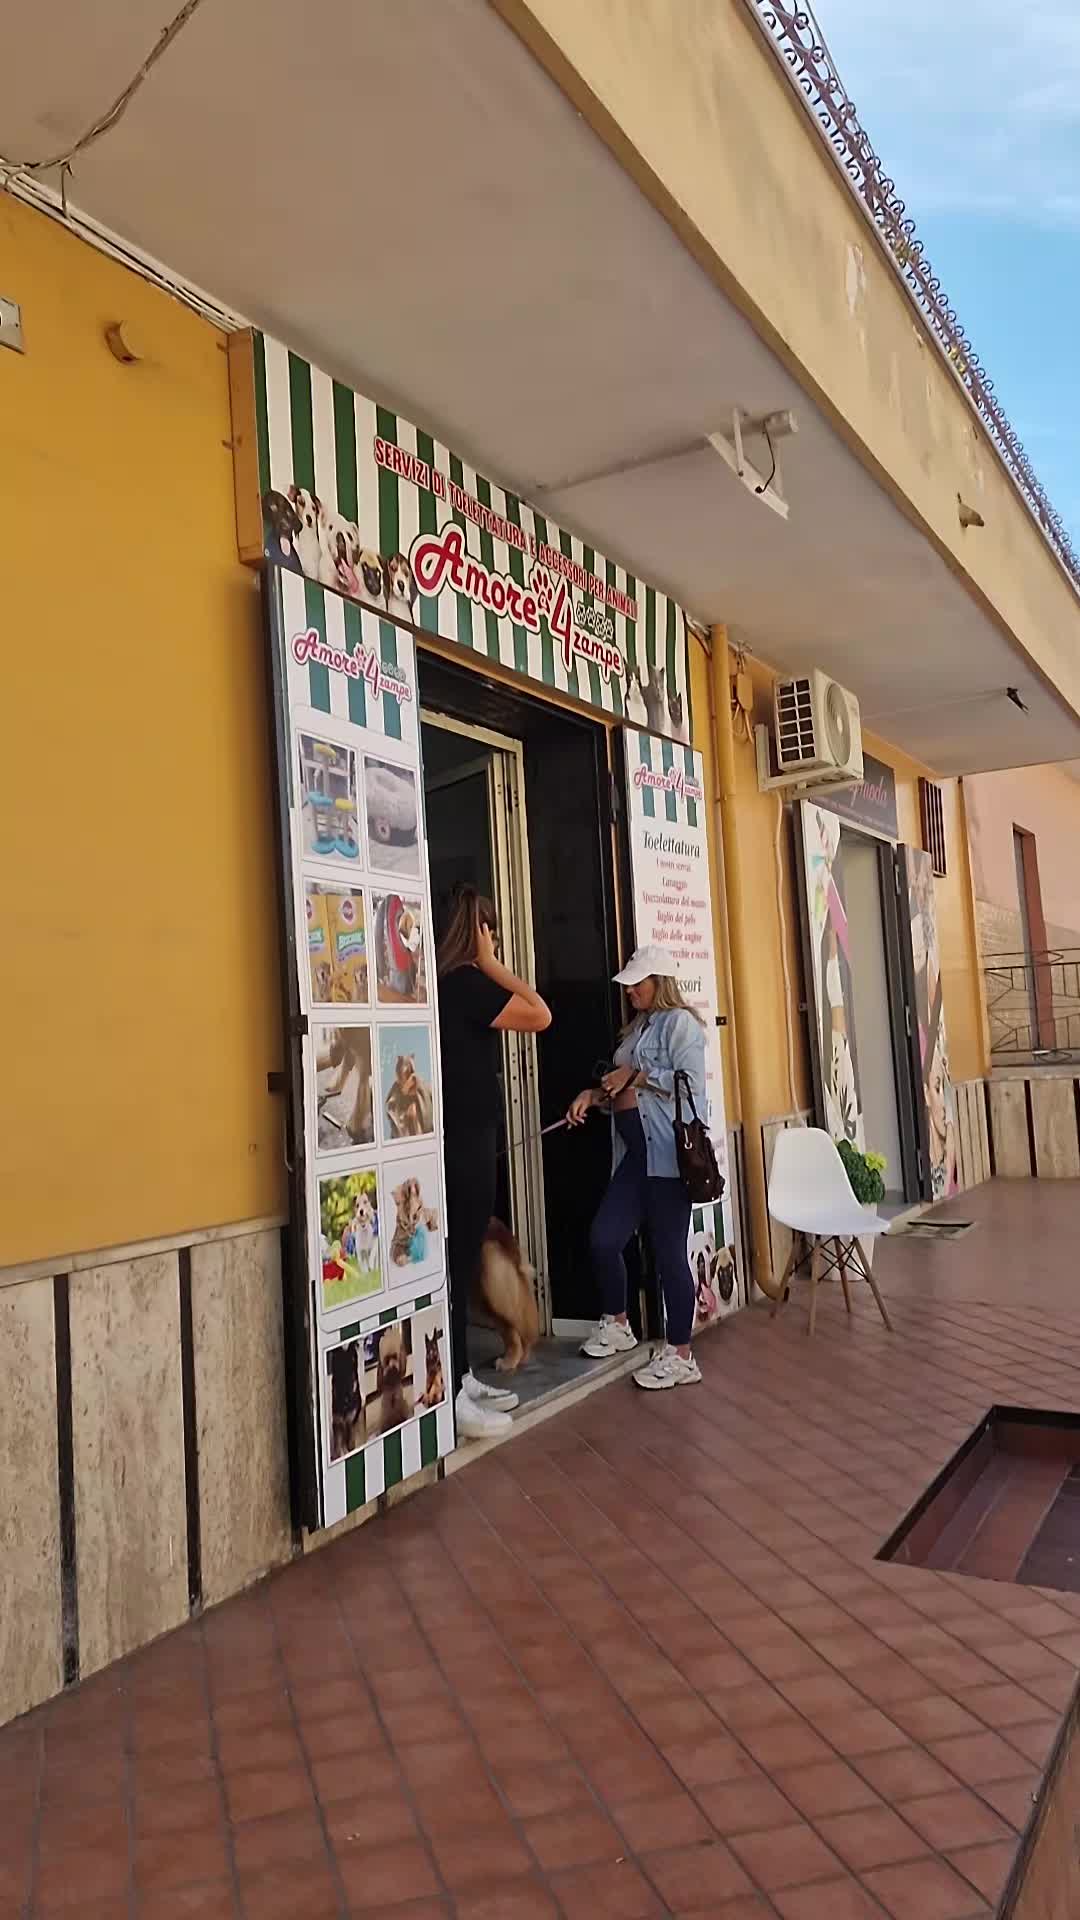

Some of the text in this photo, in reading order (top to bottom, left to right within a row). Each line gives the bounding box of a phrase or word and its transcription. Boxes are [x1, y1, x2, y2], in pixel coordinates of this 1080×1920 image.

[375, 437, 640, 621] SERVIZI DI TOELETTATURA E ACCESSORI PER ANIMALI
[412, 528, 622, 680] Amore 4 zampe
[293, 631, 411, 702] Amore 4 zampe
[633, 766, 671, 789] Amore
[675, 771, 684, 800] 4
[643, 830, 700, 858] Toelettatura
